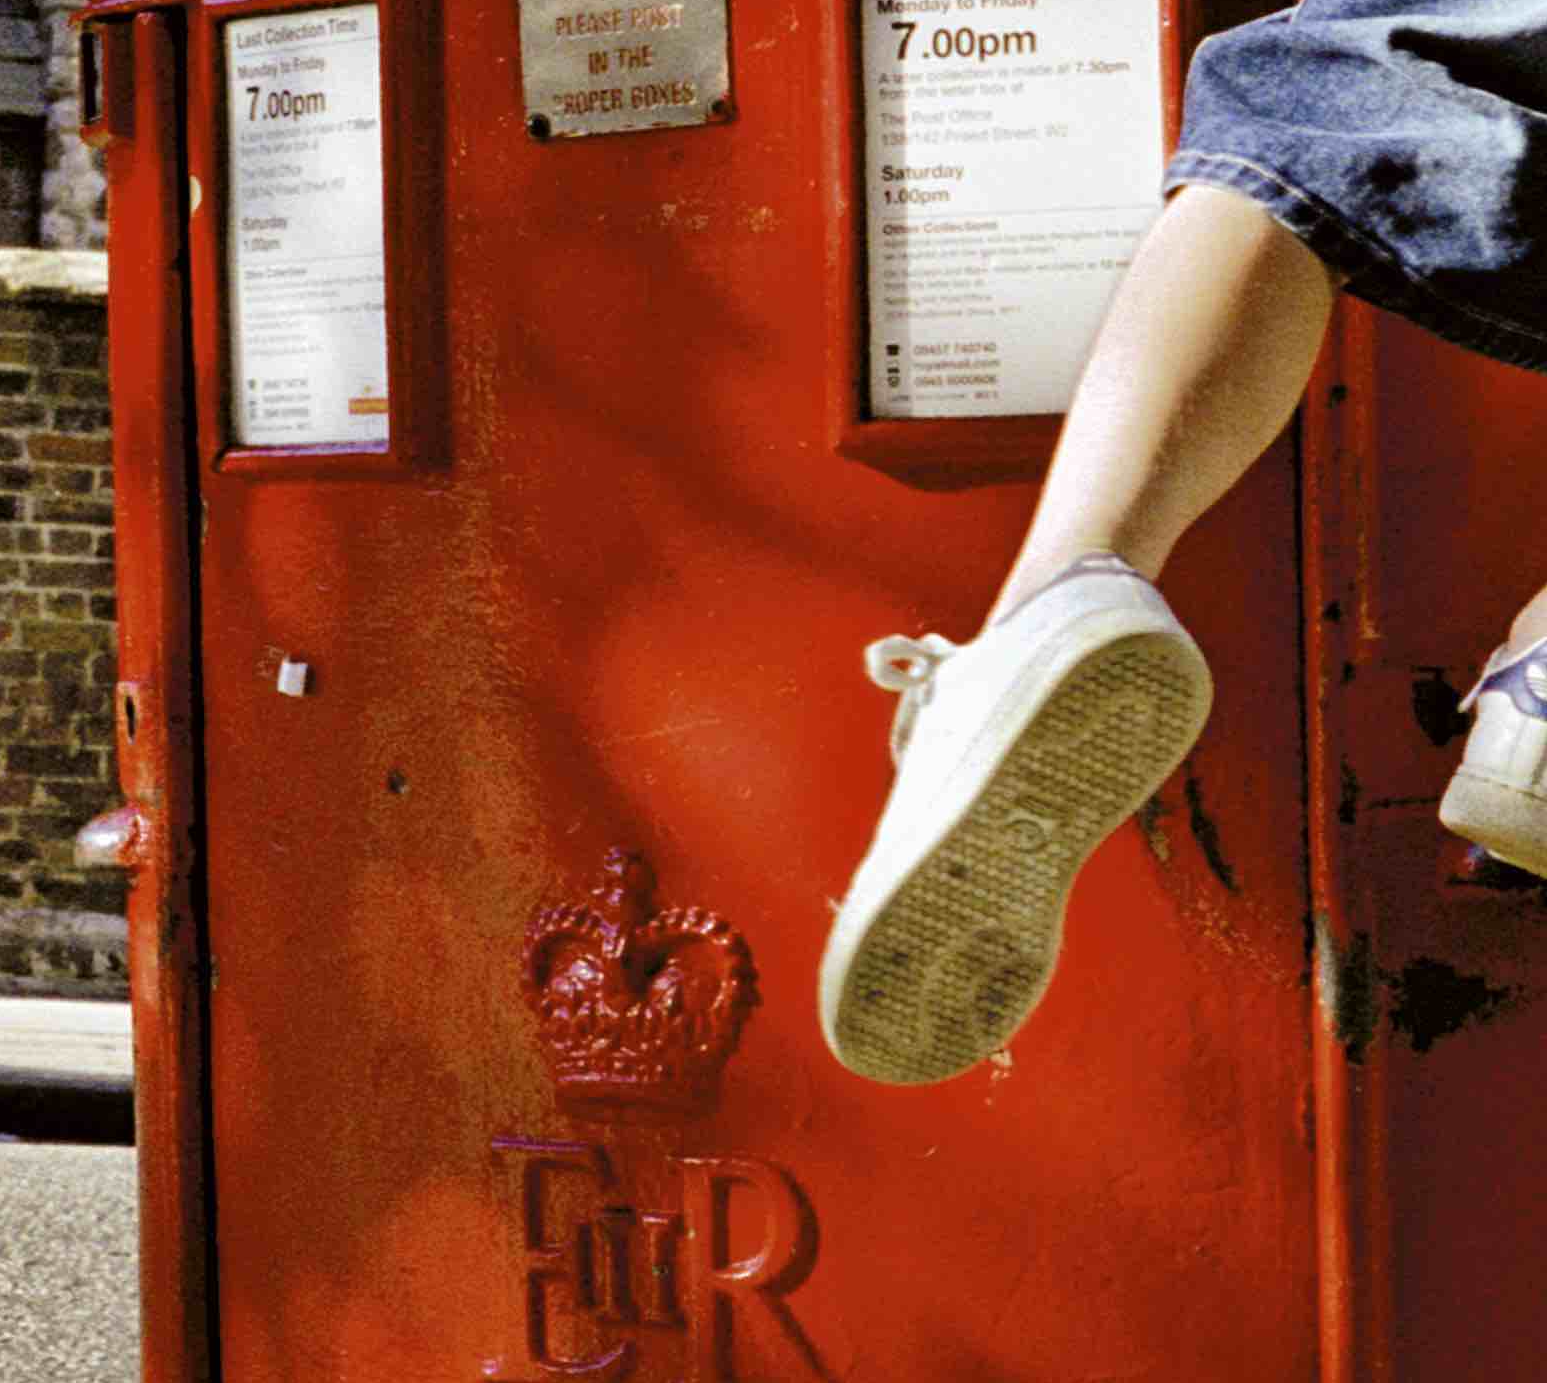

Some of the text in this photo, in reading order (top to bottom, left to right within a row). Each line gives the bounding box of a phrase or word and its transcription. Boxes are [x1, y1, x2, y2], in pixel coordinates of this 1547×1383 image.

[236, 18, 359, 49] Last Collection Time
[556, 4, 684, 35] PLEASE POST
[891, 21, 1037, 62] 7.00pm
[588, 45, 652, 74] IN THE
[246, 86, 326, 122] 7.00pm
[631, 81, 696, 109] BOXES
[882, 164, 964, 182] Saturday
[883, 188, 950, 205] 1.00pm
